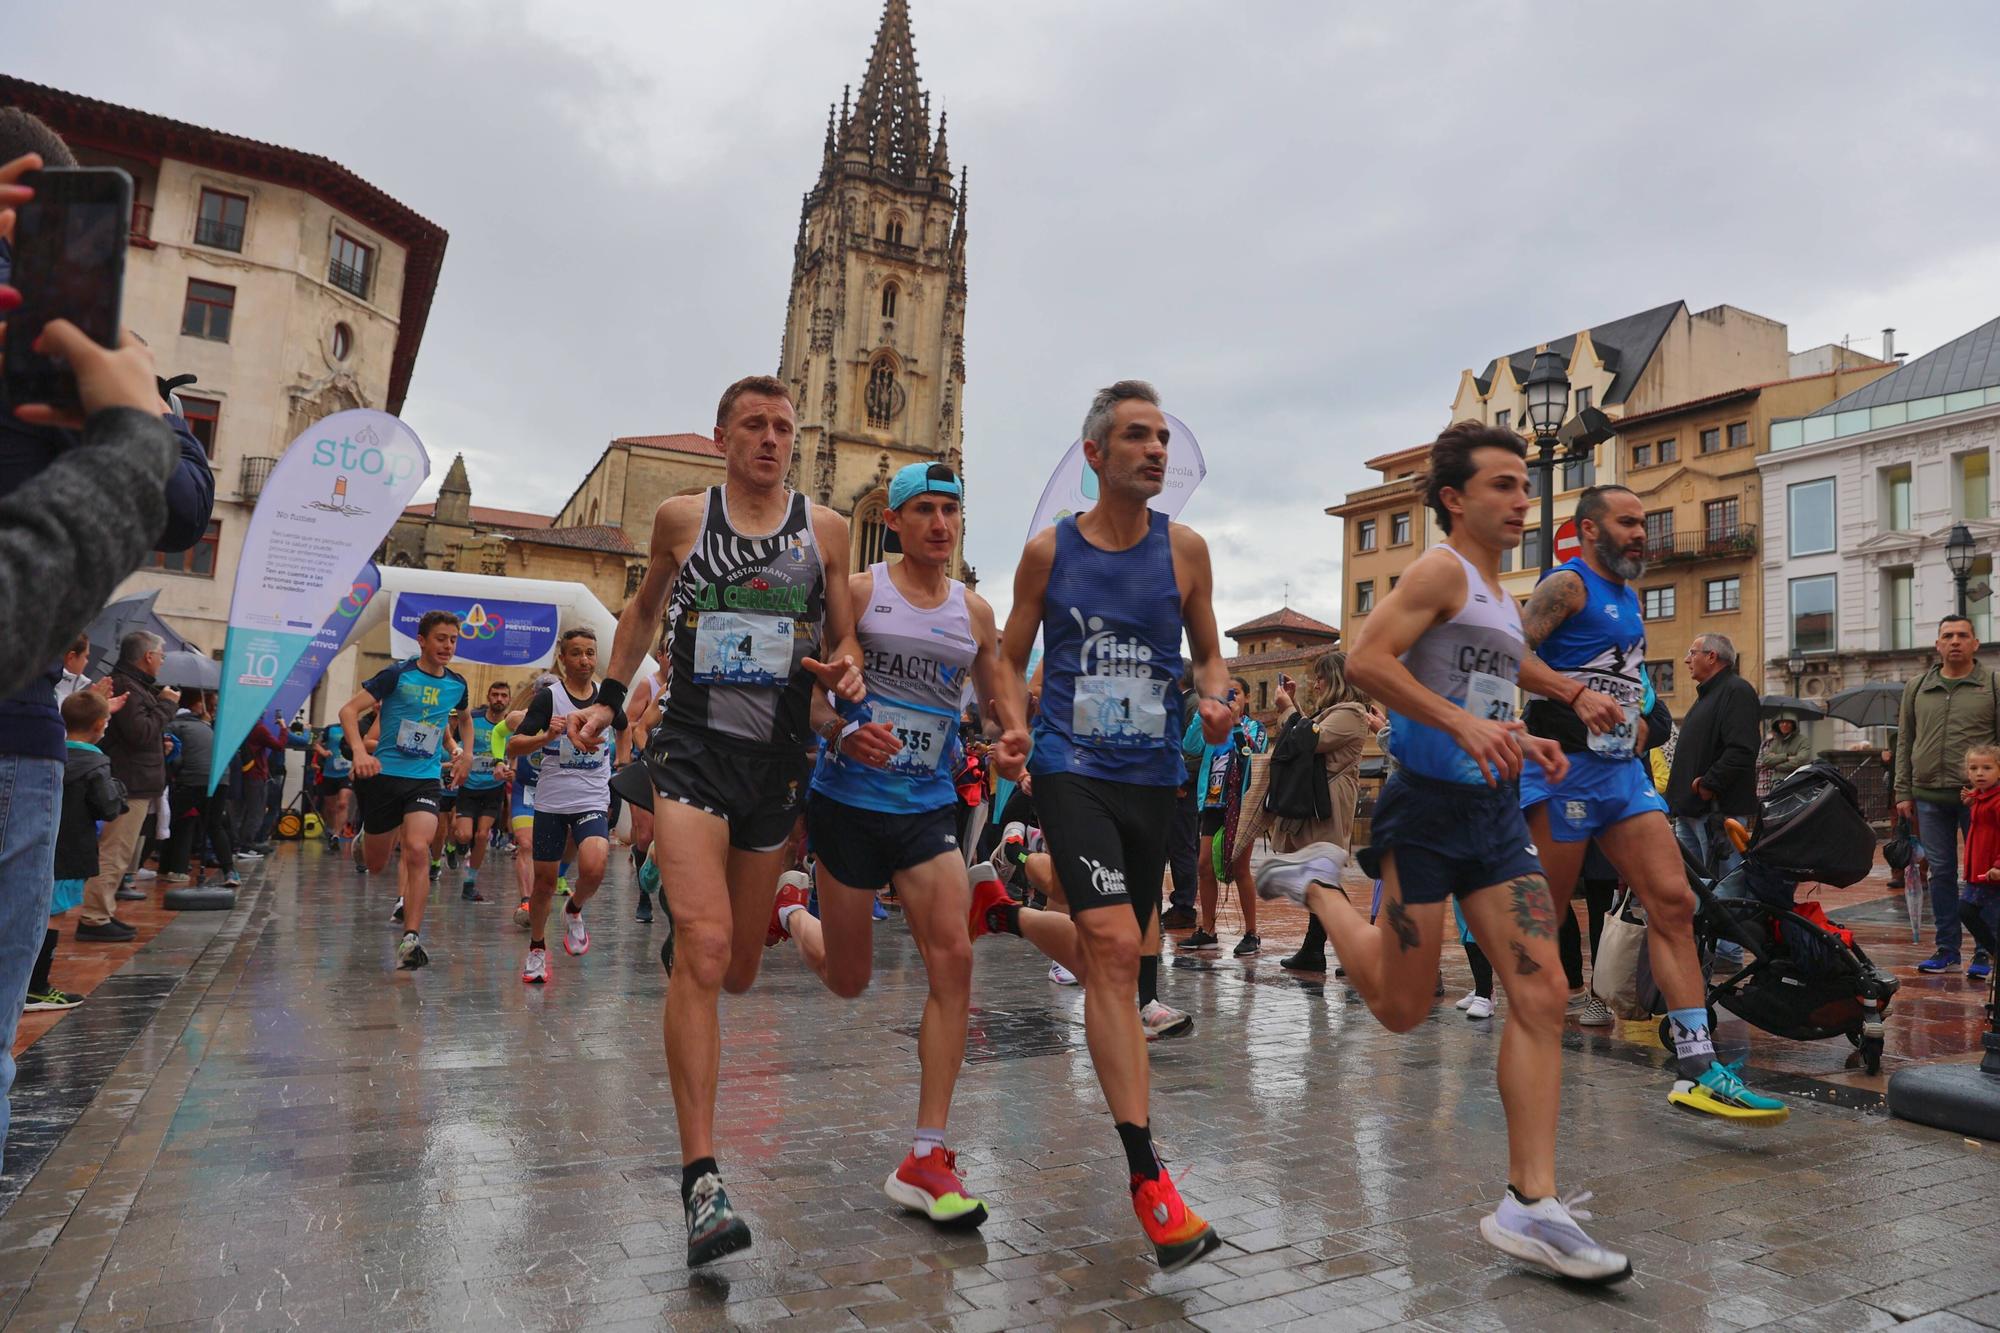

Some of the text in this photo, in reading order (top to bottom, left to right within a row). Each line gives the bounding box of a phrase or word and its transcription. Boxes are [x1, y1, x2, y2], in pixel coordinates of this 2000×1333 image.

[312, 436, 416, 486] stop
[1167, 465, 1193, 477] trola
[1166, 480, 1184, 489] eso
[276, 511, 288, 519] No
[263, 575, 292, 585] personas
[293, 579, 305, 587] que
[726, 565, 793, 584] RESTAURANTE
[695, 578, 808, 613] LA CEREZAL
[504, 624, 551, 634] PREVENTIVOS
[777, 621, 790, 635] 5K
[738, 635, 752, 657] 4
[1096, 635, 1153, 662] Fisio
[240, 652, 279, 678] 10
[422, 686, 440, 706] 5K
[1121, 697, 1130, 719] 1
[414, 731, 428, 744] 57
[897, 728, 932, 752] 335
[1100, 868, 1125, 882] Fisio
